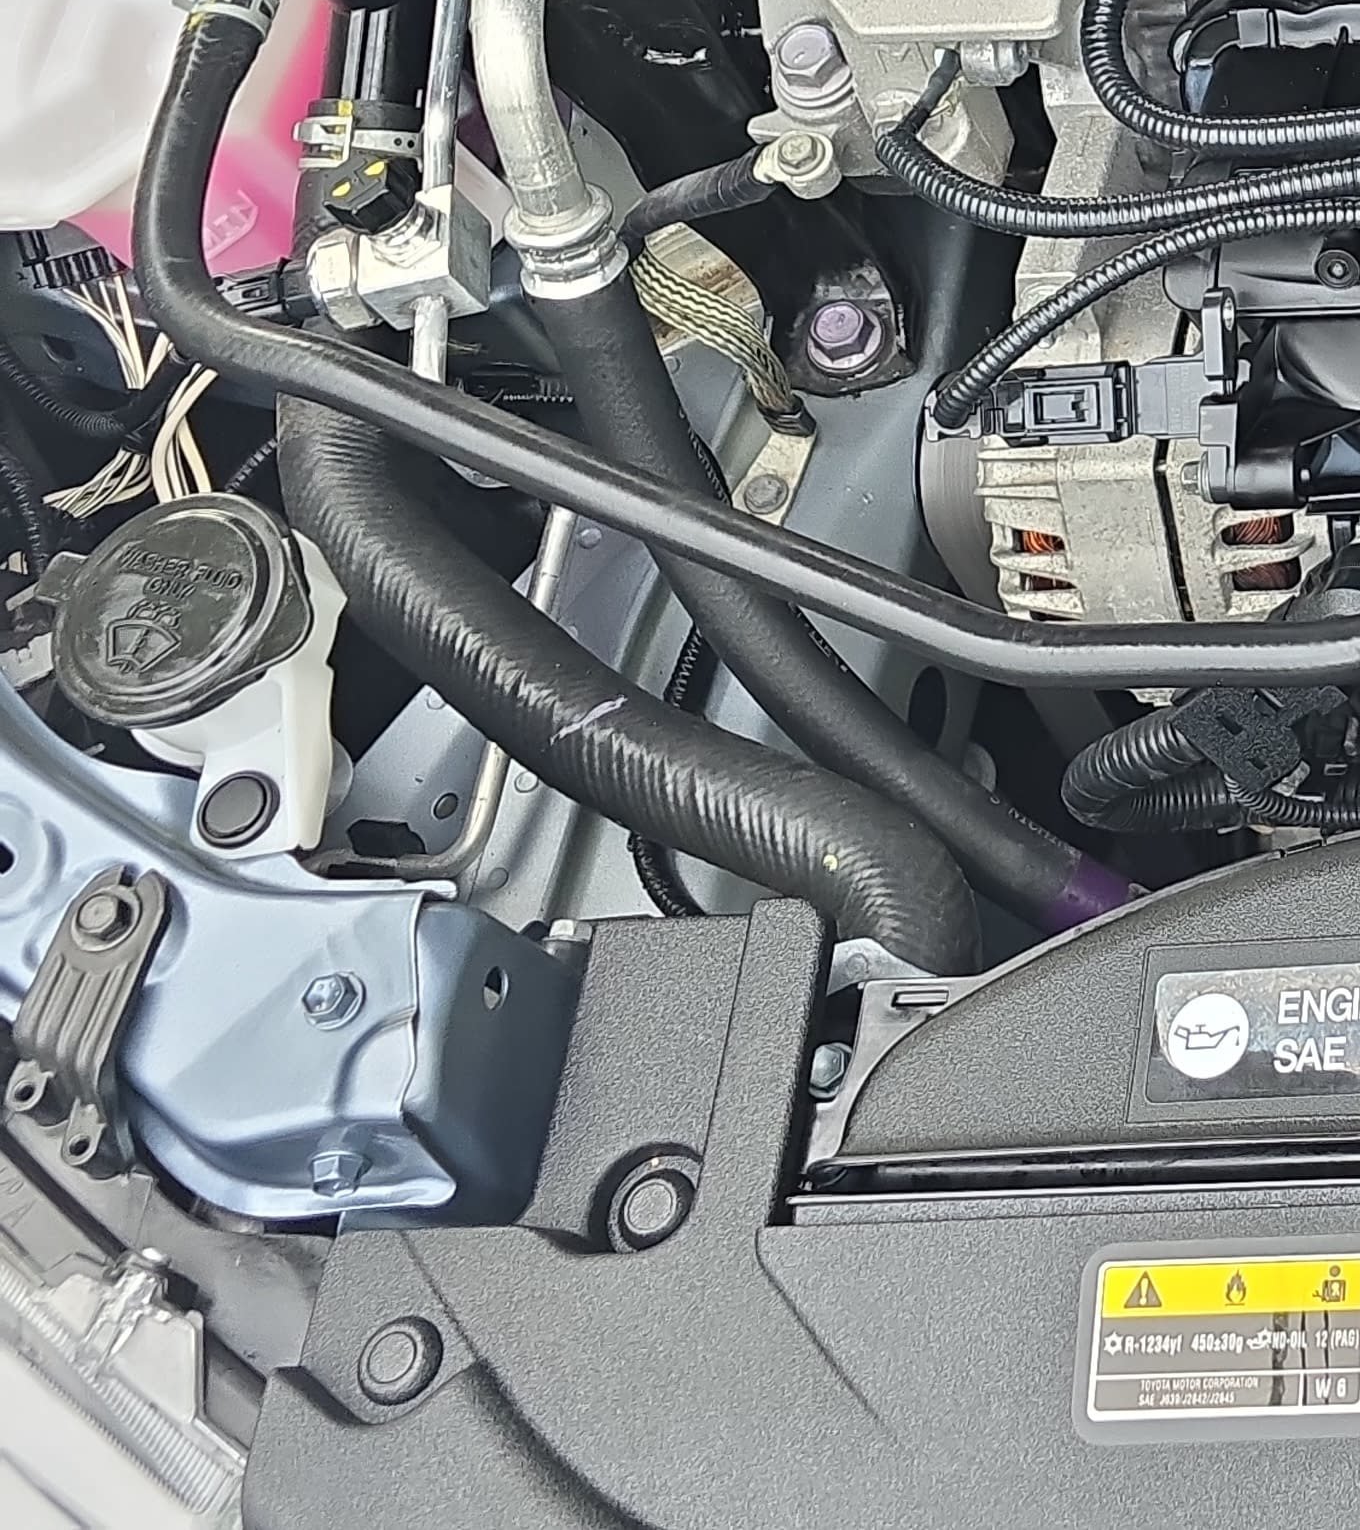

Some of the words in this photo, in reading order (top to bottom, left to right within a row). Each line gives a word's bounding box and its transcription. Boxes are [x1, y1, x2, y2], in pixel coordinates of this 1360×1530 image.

[120, 548, 190, 579] WASHER
[1273, 1036, 1347, 1074] SAE
[1190, 1334, 1243, 1354] 450±30g
[1315, 1330, 1328, 1349] 12
[1331, 1330, 1360, 1350] (PAG)
[1140, 1379, 1170, 1391] TOYOTA
[1172, 1378, 1201, 1390] MOTOR
[1202, 1376, 1259, 1390] CORPORATION
[1315, 1378, 1331, 1398] W
[1138, 1394, 1155, 1407] SAE
